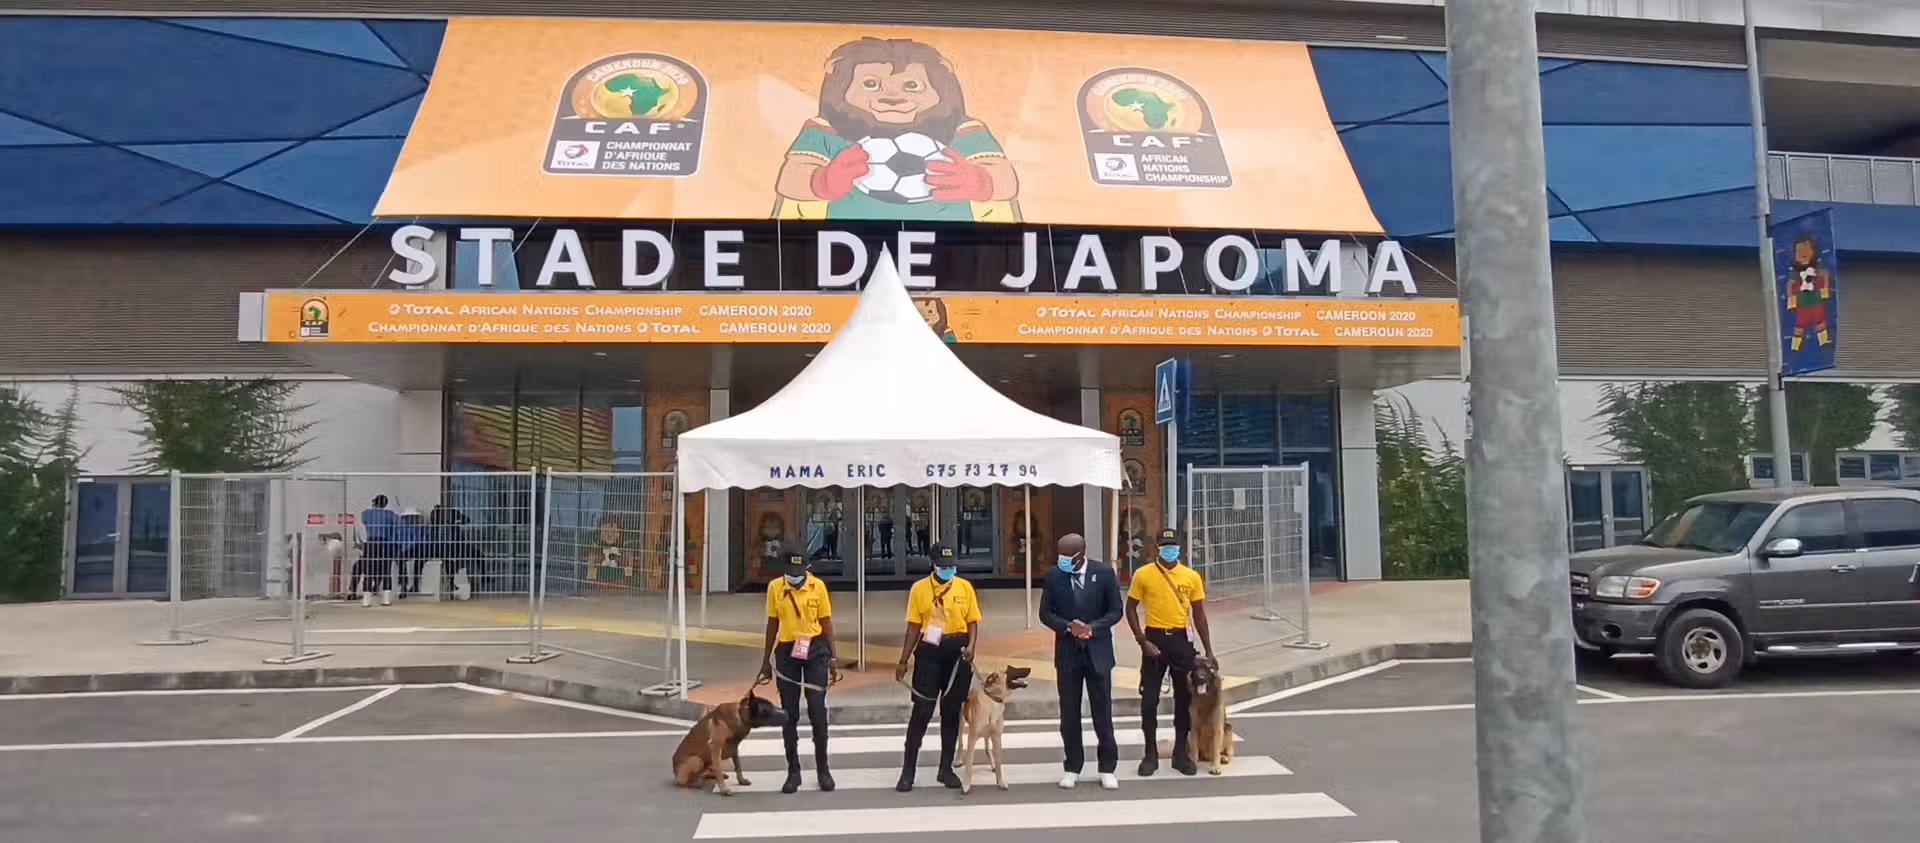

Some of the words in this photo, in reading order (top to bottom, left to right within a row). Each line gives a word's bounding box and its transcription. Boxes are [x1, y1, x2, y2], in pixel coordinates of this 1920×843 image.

[584, 121, 671, 135] CAF
[606, 141, 692, 151] CHAMPIONNAT
[1112, 134, 1191, 149] CAF
[604, 151, 667, 161] D'AFRIQUE
[1141, 154, 1188, 164] AFRICAN
[602, 161, 626, 170] DES
[629, 161, 681, 171] NATIONS
[1143, 164, 1191, 173] NATIONS
[1145, 174, 1228, 184] CHAMPIONSHIP
[388, 225, 746, 290] STADE
[818, 230, 937, 288] DE
[1000, 231, 1418, 295] JAPOMA
[699, 305, 778, 316] CAMEROON
[782, 305, 812, 317] 2020
[1316, 310, 1387, 321] CAMEROON
[1389, 311, 1416, 321] 2020
[719, 323, 797, 333] CAMEROUN
[801, 323, 831, 334] 2020
[1334, 326, 1404, 337] CAMEROUN
[1407, 327, 1433, 337] 2020
[769, 464, 825, 478] MAMA
[847, 464, 886, 478] ERIC
[926, 464, 957, 477] 675
[964, 464, 981, 477] 73
[987, 464, 1009, 477] 17
[1019, 464, 1038, 477] 94
